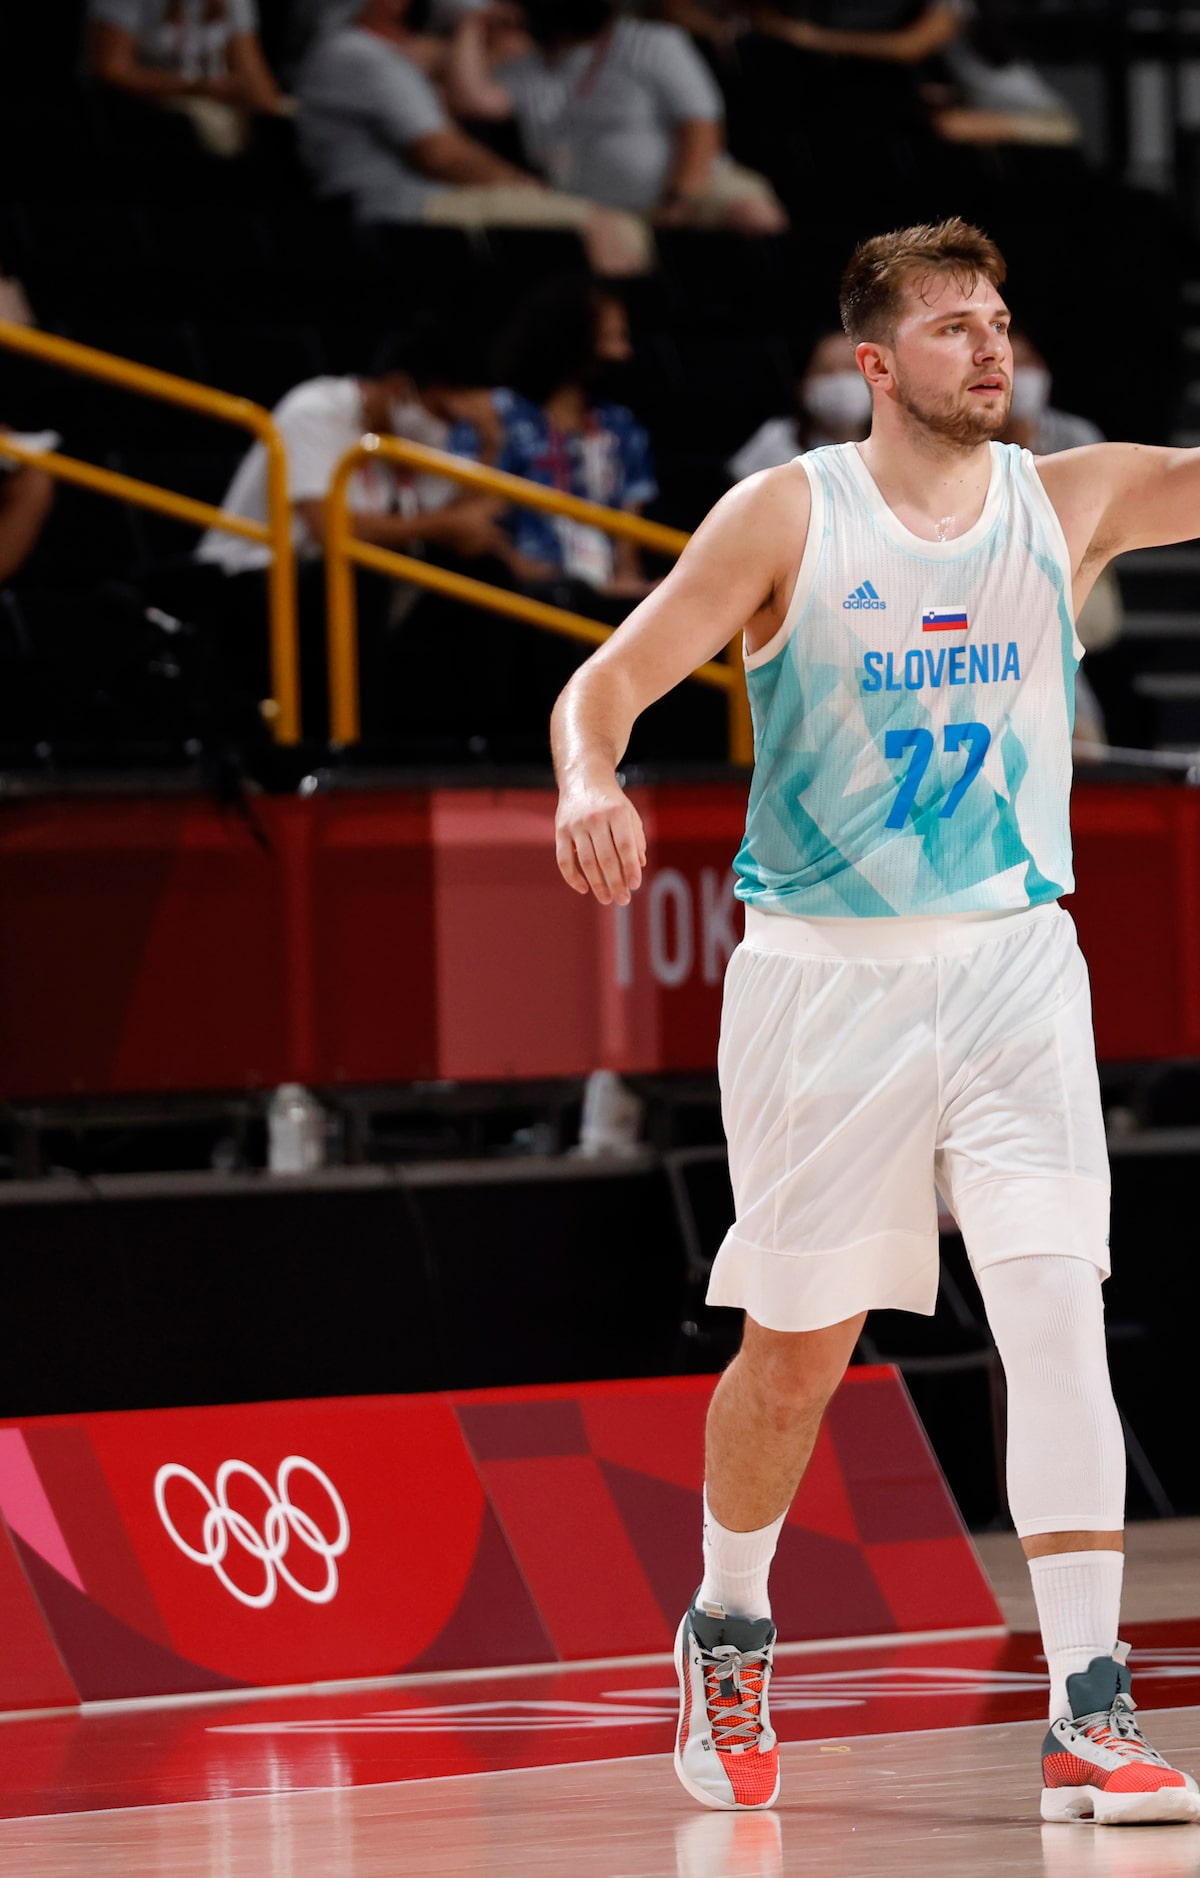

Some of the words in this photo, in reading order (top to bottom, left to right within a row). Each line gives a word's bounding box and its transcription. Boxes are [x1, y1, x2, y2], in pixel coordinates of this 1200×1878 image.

[842, 597, 887, 610] adidas
[862, 641, 1021, 692] SLOVENIA
[884, 722, 991, 829] 77
